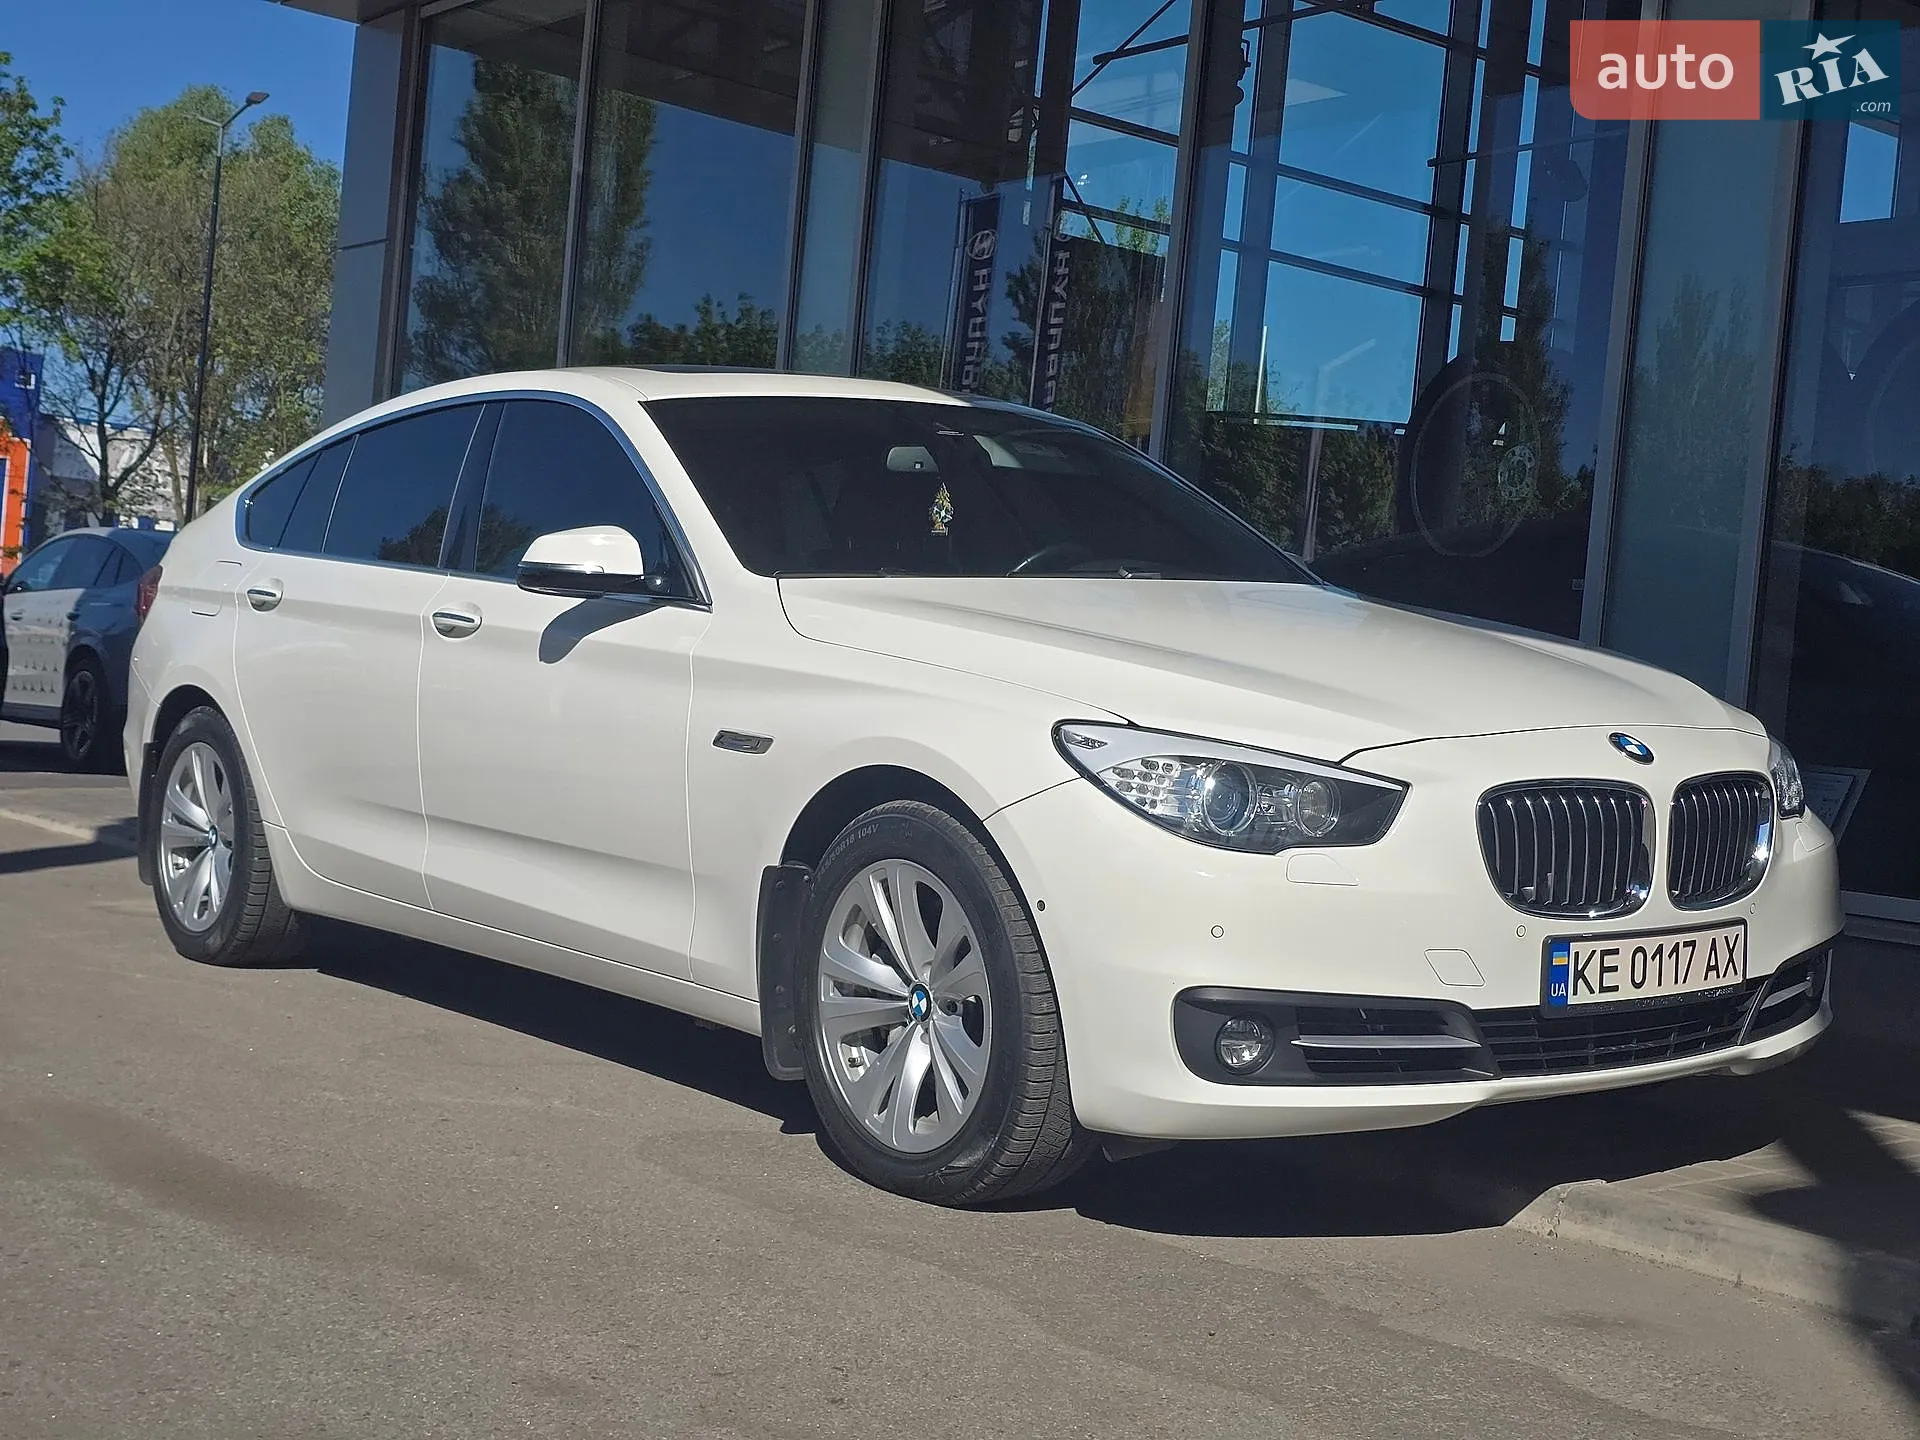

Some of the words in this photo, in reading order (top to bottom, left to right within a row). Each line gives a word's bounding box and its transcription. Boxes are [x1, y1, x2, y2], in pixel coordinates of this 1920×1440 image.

[961, 268, 992, 393] HYUND
[1551, 982, 1567, 997] UA
[1572, 947, 1620, 996] KE
[1630, 940, 1697, 989] 0117
[1704, 933, 1740, 981] AX
